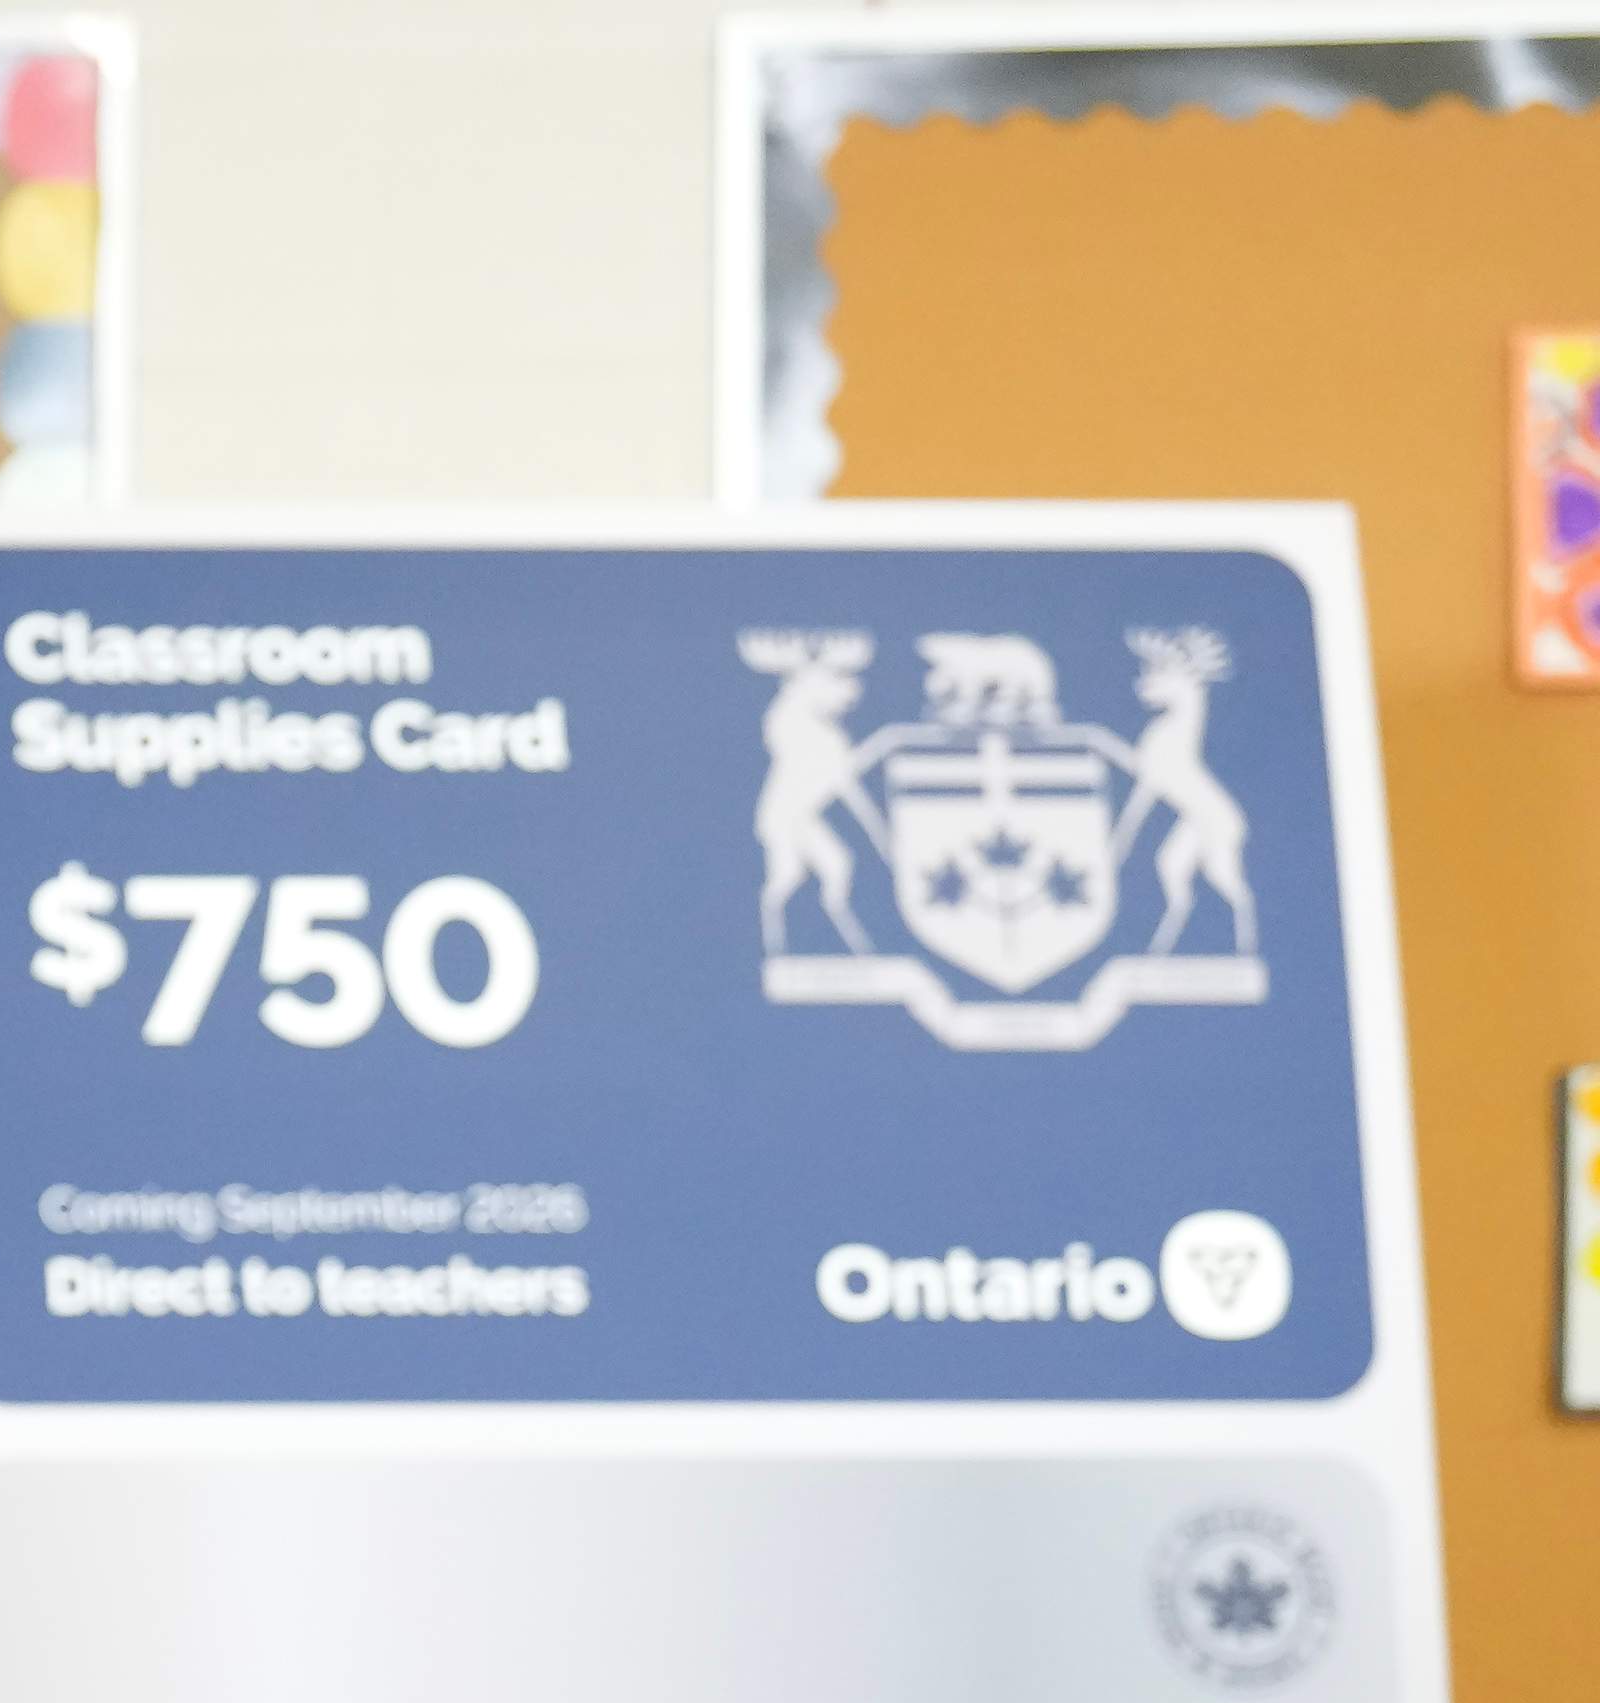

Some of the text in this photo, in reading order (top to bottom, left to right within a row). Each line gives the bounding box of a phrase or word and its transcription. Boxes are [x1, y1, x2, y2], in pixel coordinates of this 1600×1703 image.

[4, 610, 433, 685] Classroom
[11, 698, 570, 788] Supplies Card
[28, 860, 540, 1049] $750
[38, 1183, 217, 1243] Coming
[218, 1183, 462, 1241] September
[45, 1254, 590, 1317] Direct to teachers
[816, 1242, 1154, 1323] Ontario
